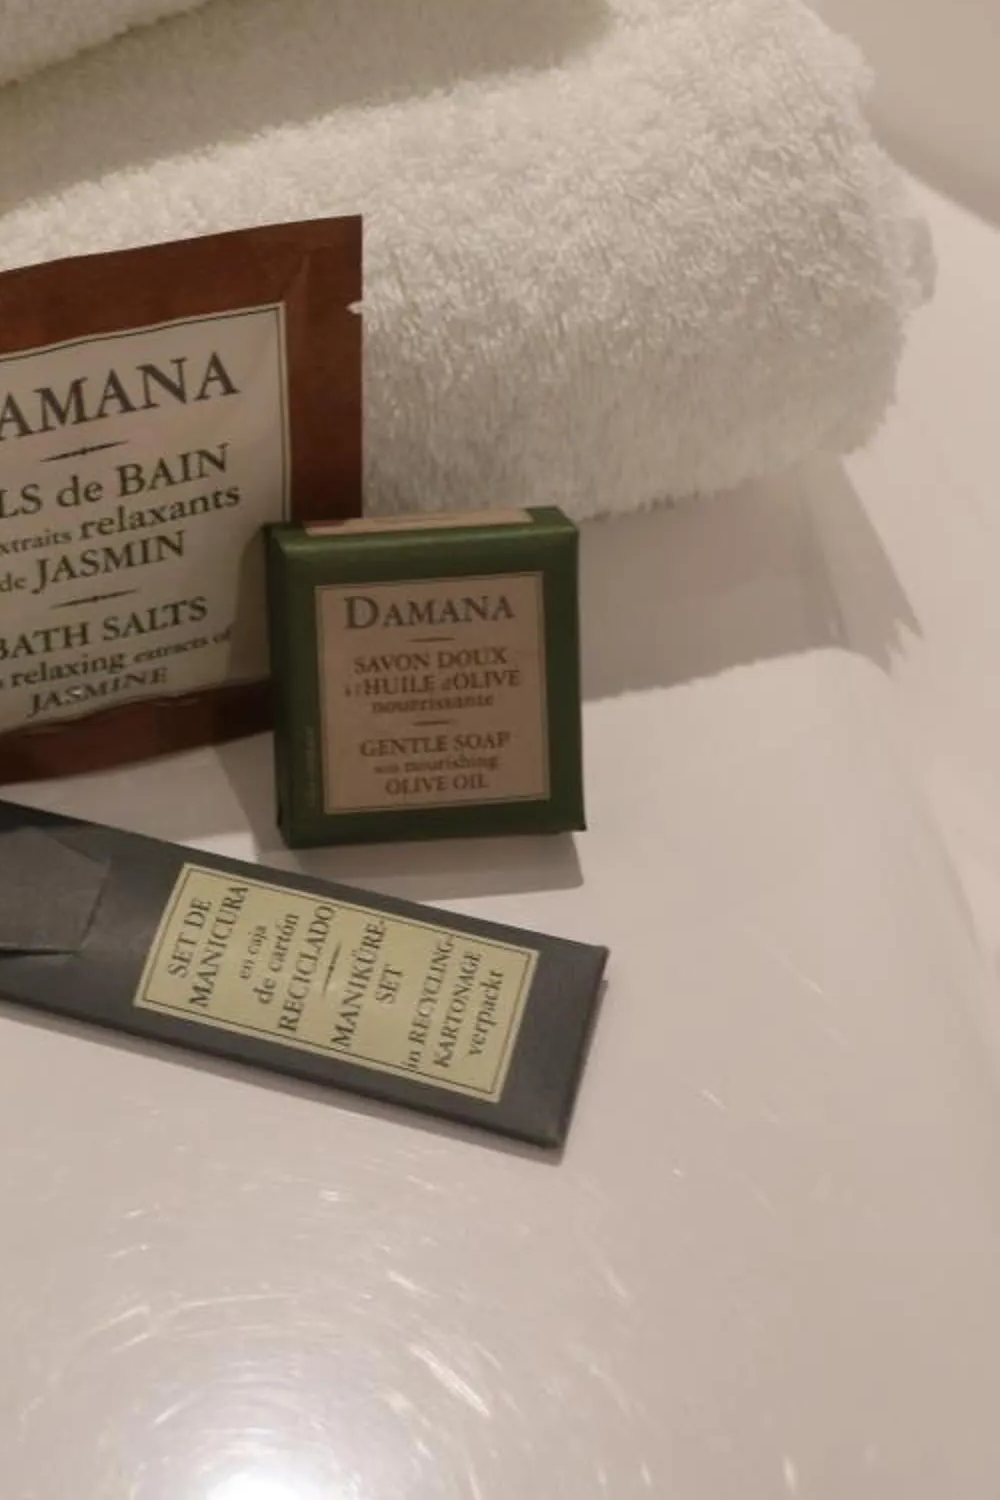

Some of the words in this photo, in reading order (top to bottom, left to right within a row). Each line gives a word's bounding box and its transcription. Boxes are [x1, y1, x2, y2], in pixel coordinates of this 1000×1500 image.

[56, 475, 104, 508] de
[115, 442, 232, 498] BAIN
[79, 485, 241, 540] relaxants
[32, 529, 185, 595] JASMIN
[103, 595, 209, 642] SALTS
[343, 594, 517, 630] DAMANA
[11, 652, 126, 688] relaxing
[133, 635, 209, 664] extracts
[212, 623, 233, 644] of
[353, 651, 431, 676] SAVON
[438, 645, 509, 670] DOUX
[25, 666, 169, 718] JASMINE
[359, 734, 448, 757] GENTLE
[453, 730, 512, 752] SOAP
[384, 775, 448, 796] OLIVE
[453, 773, 490, 791] OIL
[168, 931, 198, 979] SET
[184, 897, 212, 930] DE
[188, 886, 249, 1009] MANICURA
[247, 925, 268, 957] caja
[252, 977, 277, 1005] de
[268, 913, 300, 973] cartón
[239, 958, 256, 981] en
[277, 904, 337, 1033] RECICLADO
[375, 964, 404, 1005] SET
[432, 951, 482, 1069] KARTONAGE
[468, 969, 504, 1056] verpackt
[403, 1049, 421, 1072] in
